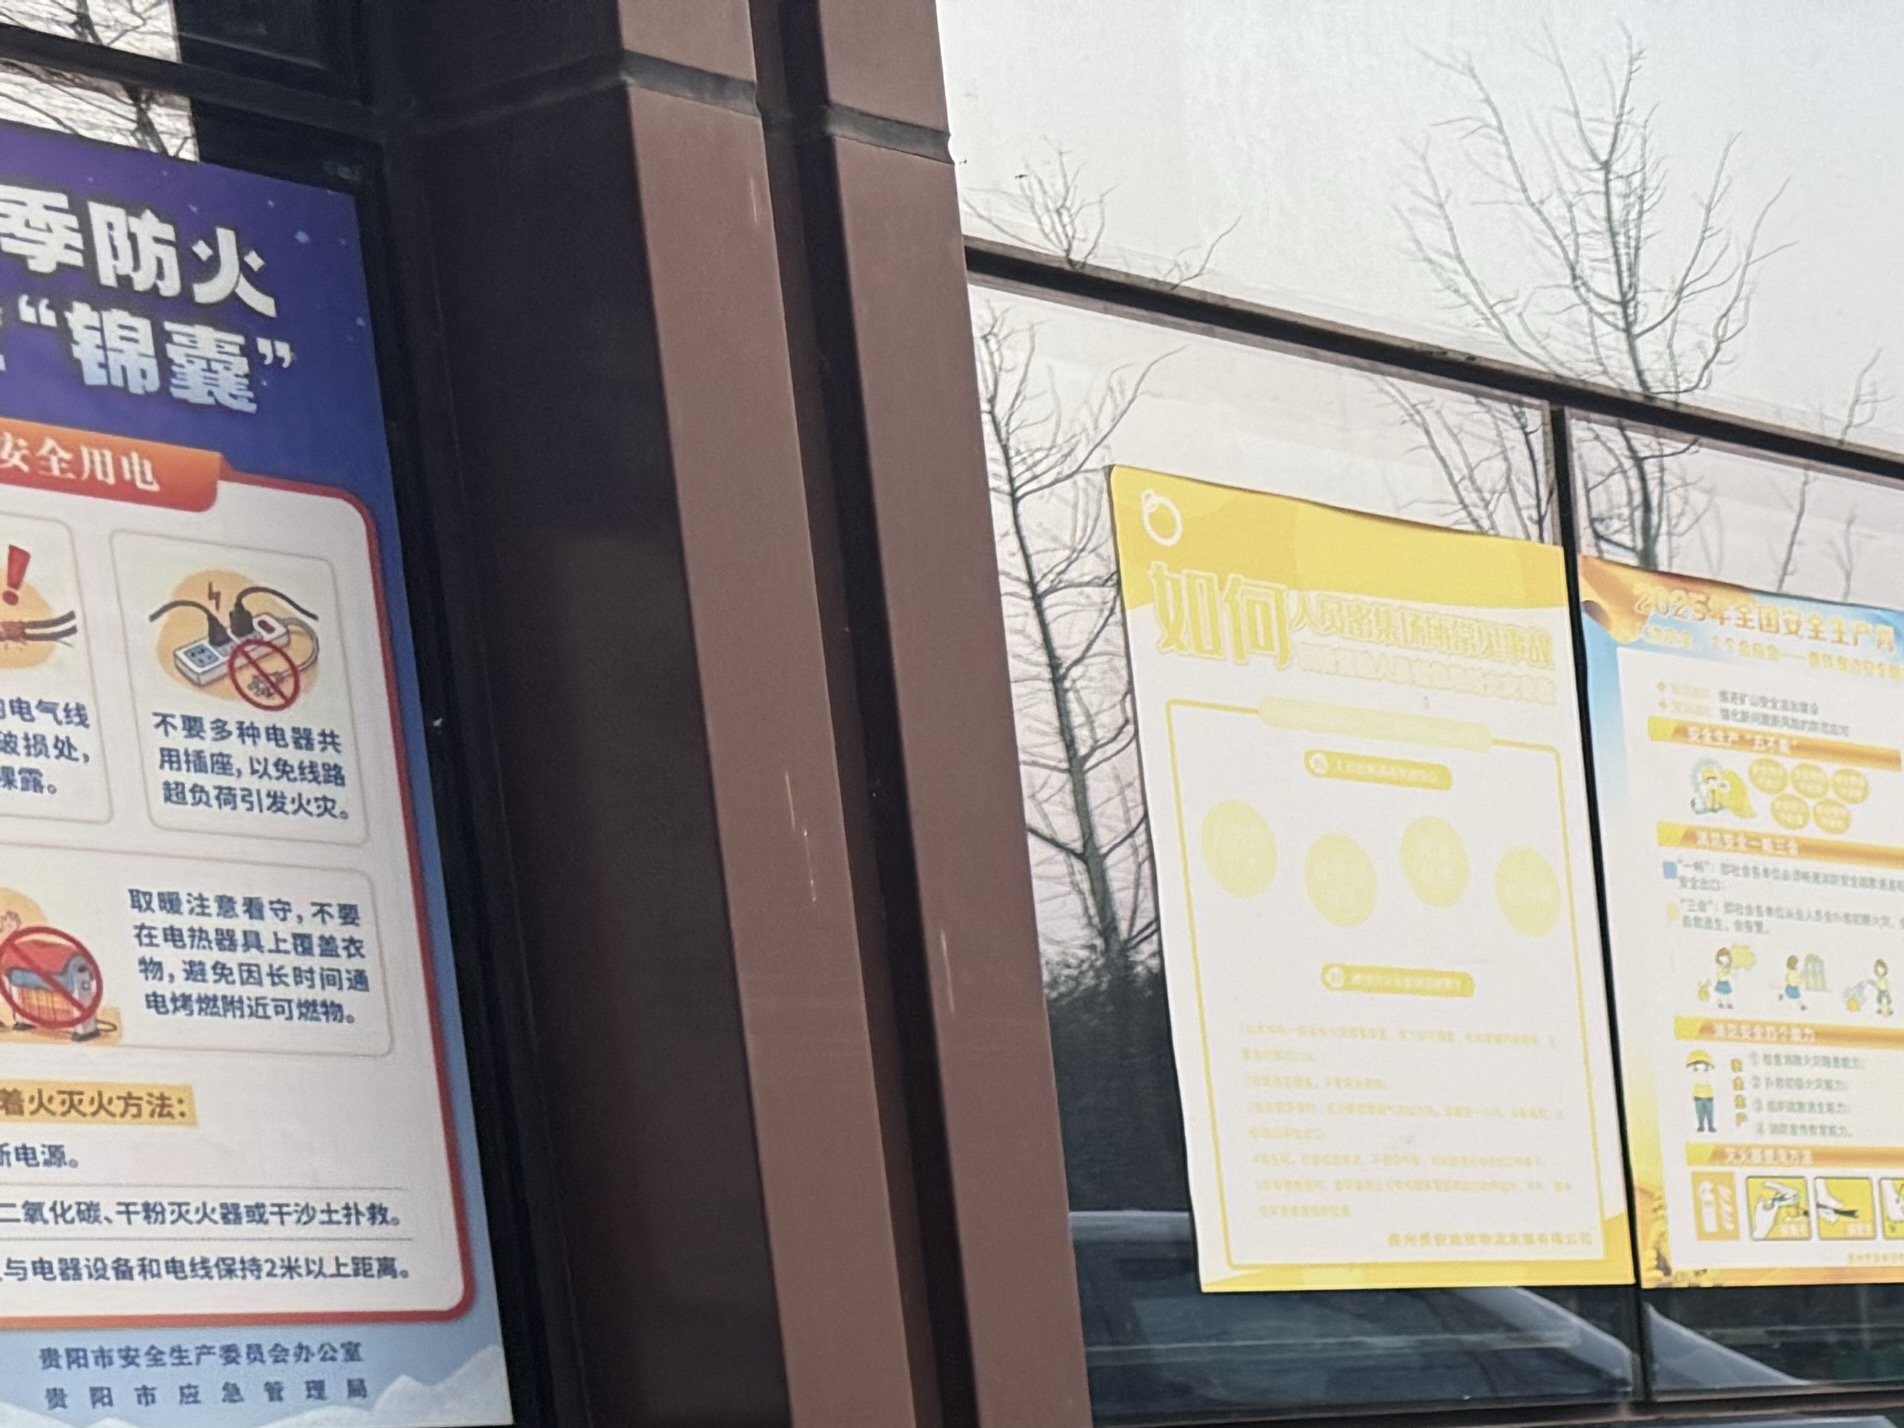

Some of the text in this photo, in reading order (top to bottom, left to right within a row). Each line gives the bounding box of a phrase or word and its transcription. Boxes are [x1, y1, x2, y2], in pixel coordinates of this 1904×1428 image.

[0, 294, 295, 413] “锦囊”
[1149, 560, 1294, 670] 如何
[0, 696, 90, 728] 电气线
[152, 712, 341, 753] 不要多种电器共
[159, 747, 346, 786] 用插座，以免线路
[163, 780, 349, 821] 超负荷引发火灾。
[129, 888, 360, 927] 取暖注意看守，不要
[134, 923, 365, 958] 在电热器具上覆盖衣
[138, 956, 370, 992] 物，避免因长时间通
[145, 992, 355, 1023] 电烤燃附近可燃物。
[0, 1201, 400, 1226] 二氧化碳、干粉灭火器或干沙土扑救。
[0, 1256, 409, 1282] 与电器设备和电线保持2米以上距离。
[39, 1341, 364, 1371] 贵阳市安全生产委员会办公室
[45, 1378, 368, 1411] 贵阳市应急管理局
